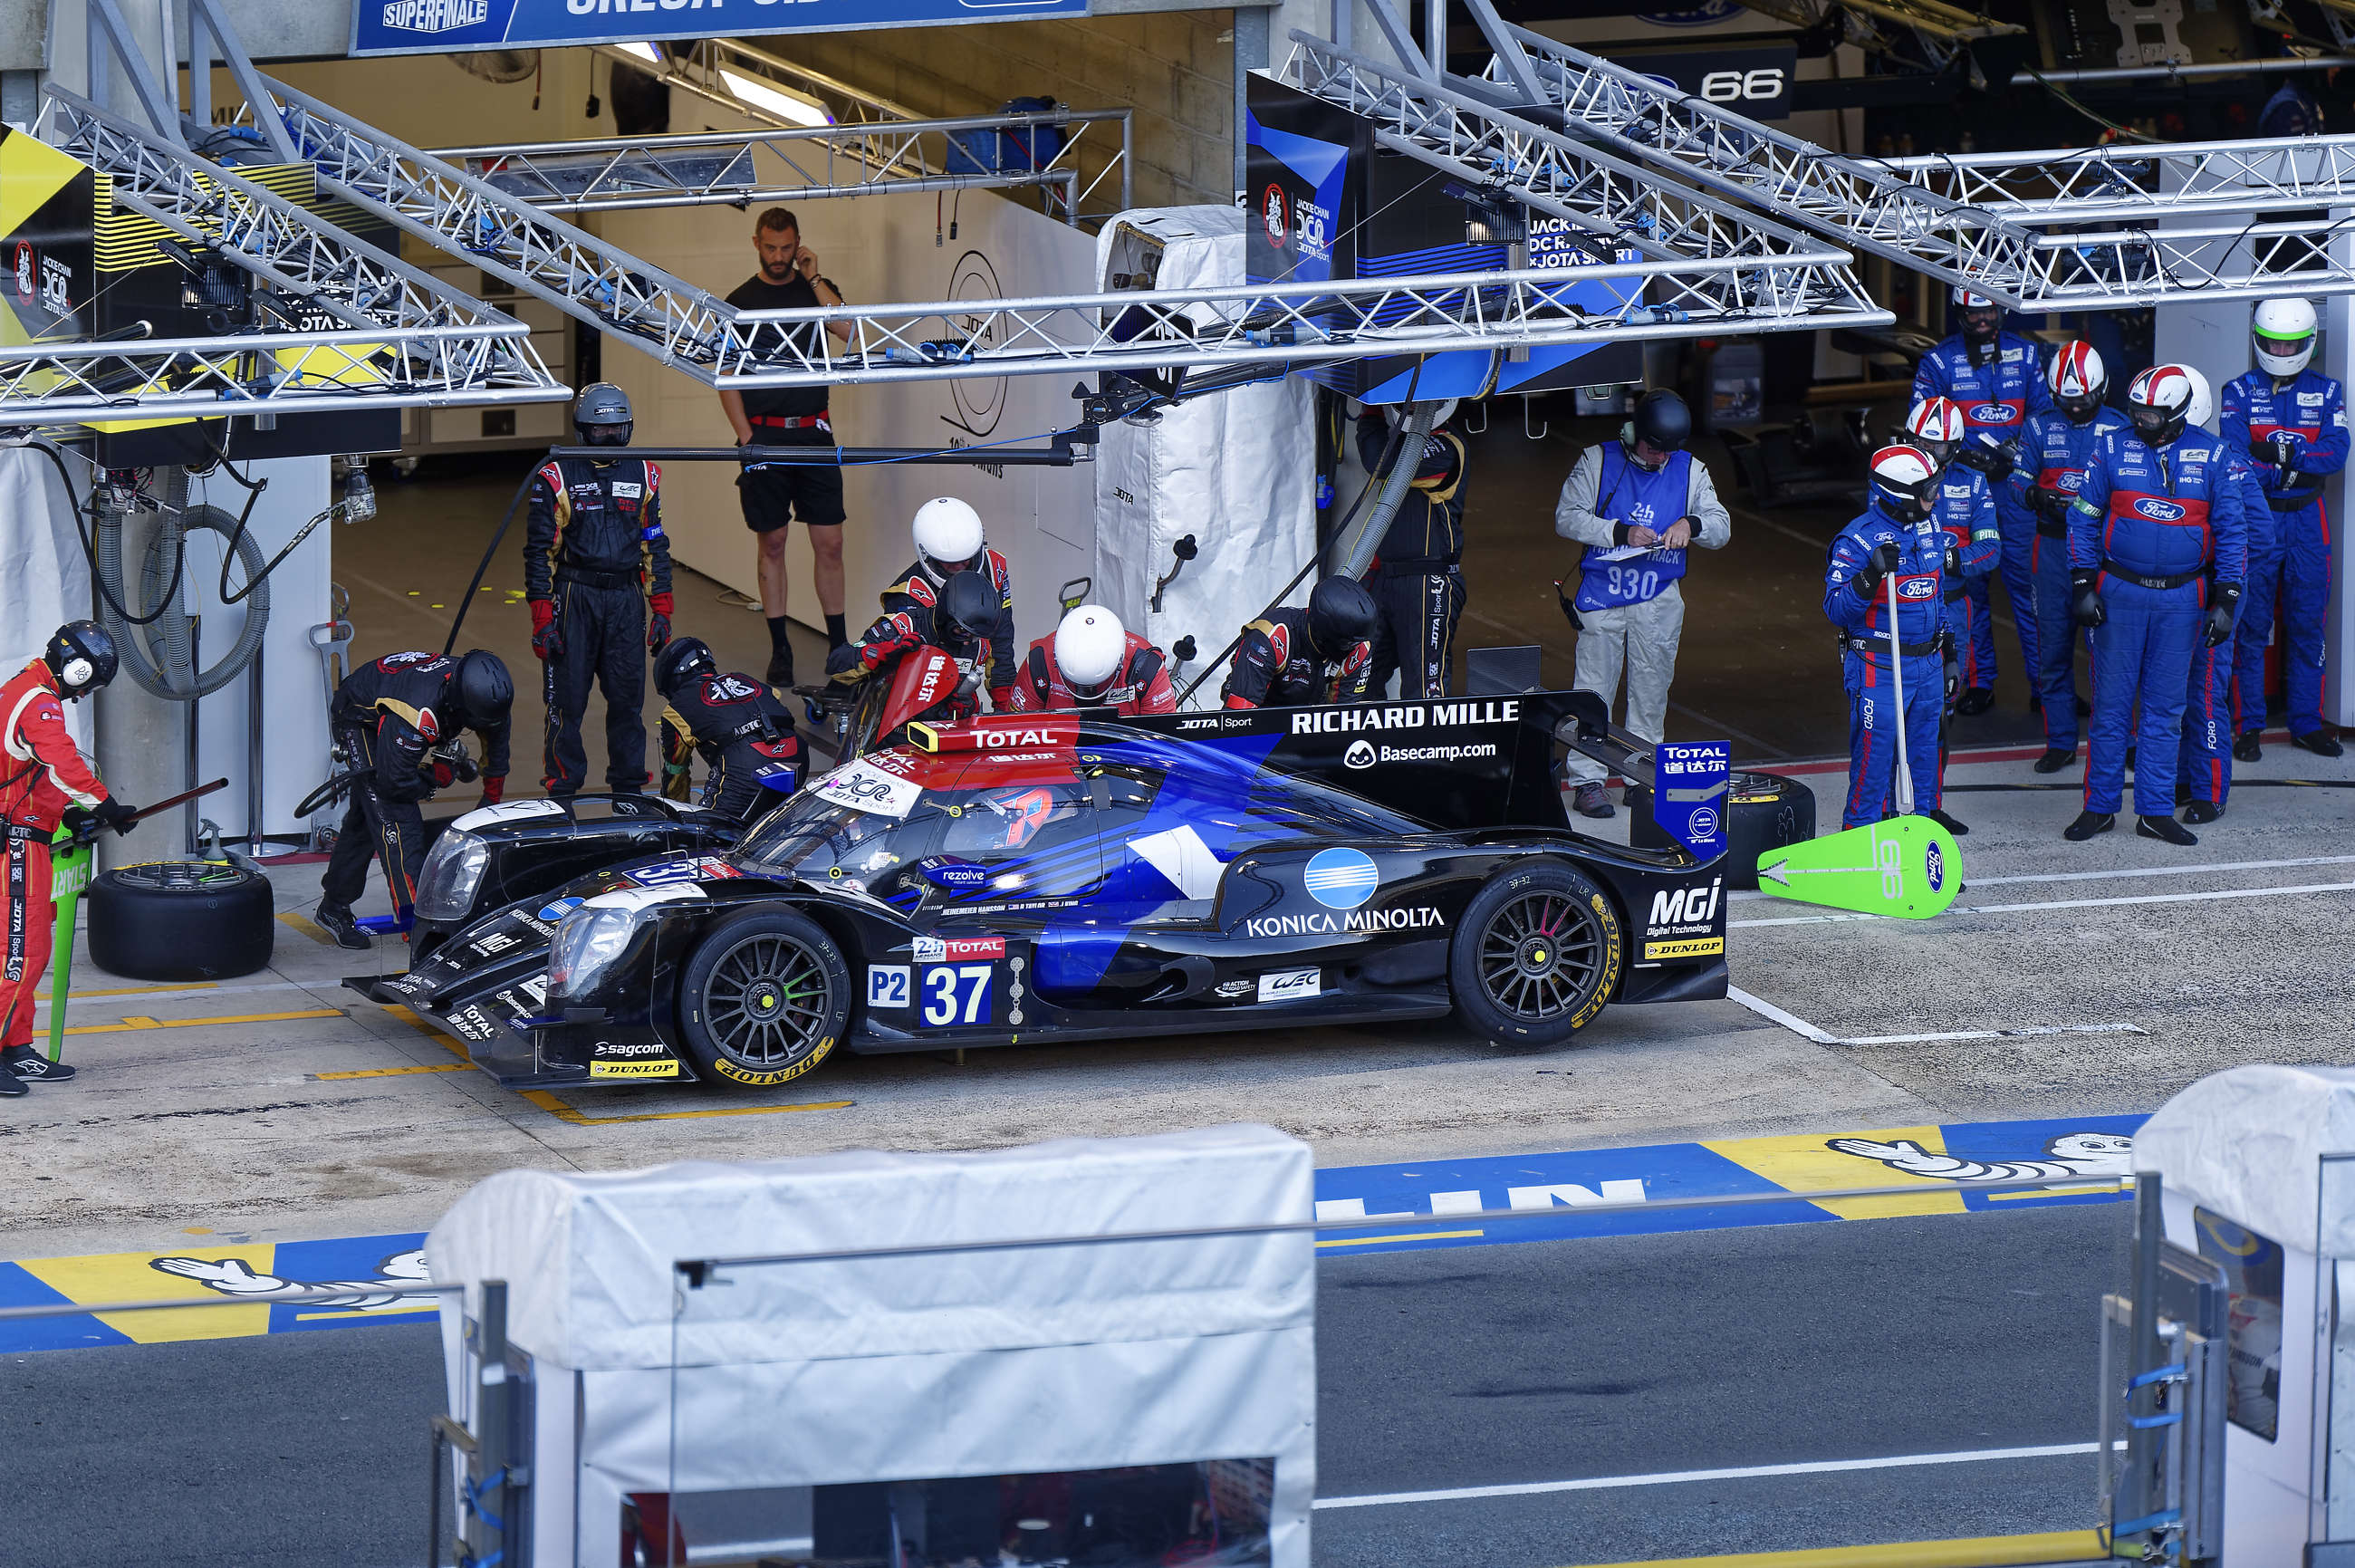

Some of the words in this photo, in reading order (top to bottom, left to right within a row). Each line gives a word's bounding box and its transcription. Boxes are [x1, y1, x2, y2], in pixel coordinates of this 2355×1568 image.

[1701, 69, 1784, 102] 66
[1530, 217, 1586, 235] JACK
[2061, 474, 2082, 489] For
[1113, 486, 1134, 505] JOTA
[2143, 501, 2177, 519] Ford
[1647, 549, 1680, 565] TRACK
[1607, 565, 1658, 601] 930
[1907, 581, 1934, 597] Ford
[1431, 618, 1440, 650] JOTA
[1176, 719, 1219, 730] JOTA
[1224, 717, 1253, 728] Sport
[1292, 707, 1426, 735] RICHARD
[1433, 699, 1520, 726] MILLE
[1864, 697, 1874, 730] FORD
[969, 728, 1058, 749] TOTAL
[2208, 721, 2216, 750] FORD
[1380, 743, 1496, 763] Basecamp.com
[1663, 746, 1727, 759] TOTAL
[1663, 760, 1726, 774] 道达尔
[943, 870, 985, 880] rezolve
[1927, 850, 1941, 883] Ford
[51, 861, 88, 901] START
[13, 898, 23, 934] JOTA
[1246, 912, 1338, 938] KONICA
[1344, 907, 1446, 931] MINOLTA
[1647, 926, 1671, 937] Digital
[1671, 924, 1712, 935] Technology
[947, 941, 1003, 953] TOTAL
[1658, 941, 1721, 955] DUNLOP
[872, 970, 906, 1002] P2
[1272, 971, 1320, 989] WEC
[924, 965, 992, 1025] 37
[505, 995, 533, 1019] Basecamp.co
[463, 1004, 495, 1038] TOTAL
[608, 1044, 664, 1057] sagcom
[607, 1063, 675, 1074] DUNLOP
[721, 1054, 815, 1084] DUNLOP
